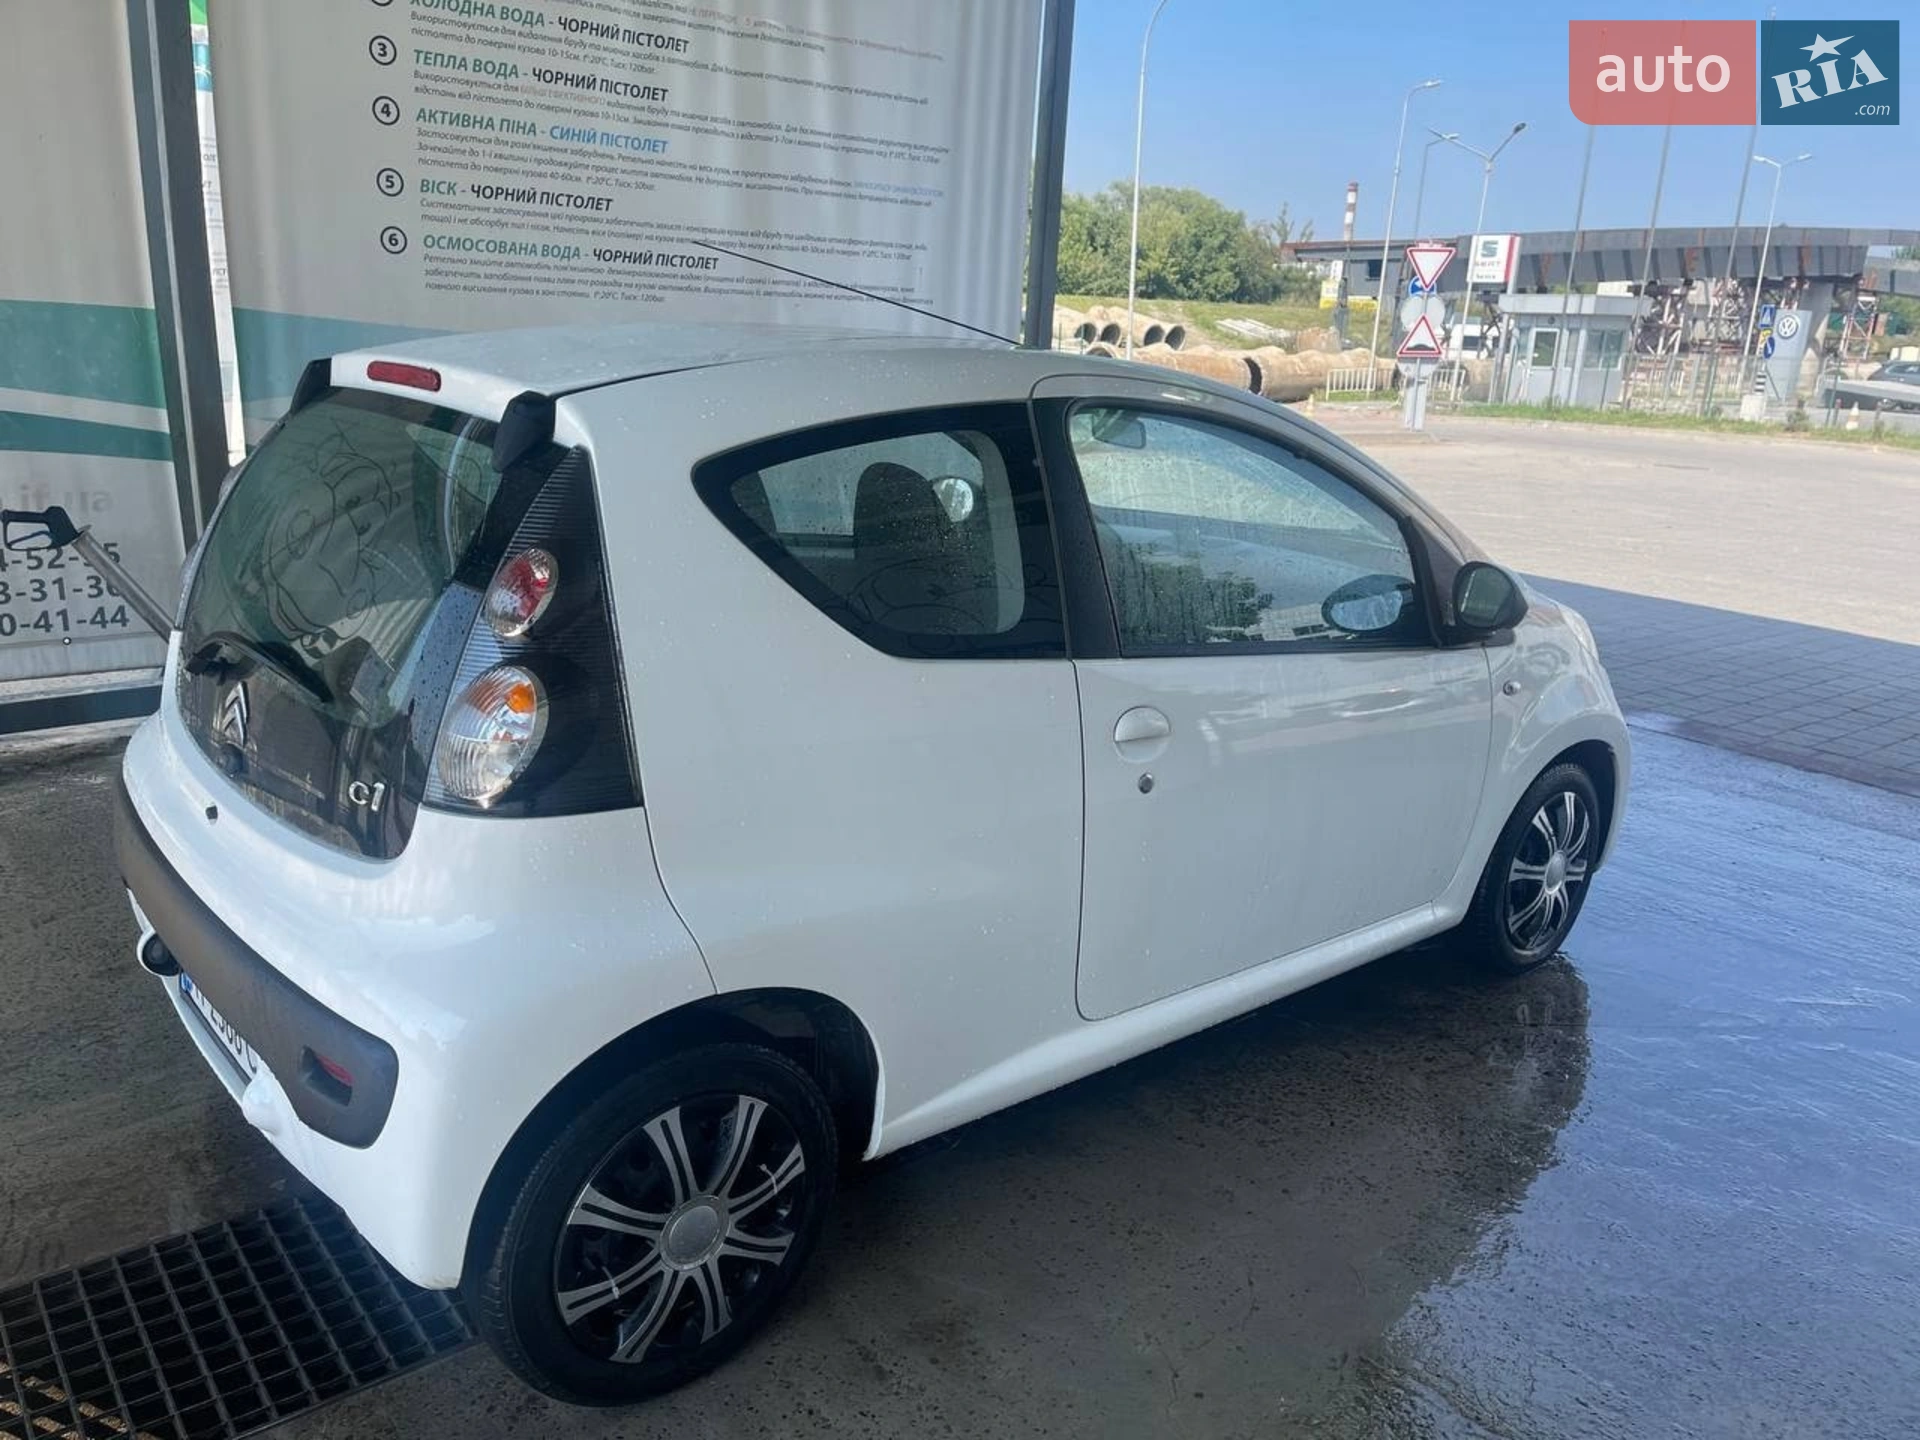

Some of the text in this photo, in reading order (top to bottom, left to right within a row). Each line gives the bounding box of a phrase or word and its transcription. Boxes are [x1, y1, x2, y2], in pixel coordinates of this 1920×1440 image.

[500, 9, 545, 28] ВОДА
[558, 16, 619, 41] ЧОРНИЙ
[622, 29, 690, 53] ПІСТОЛЕТ
[378, 43, 388, 57] 3
[414, 49, 468, 71] ТЕПЛА
[472, 58, 519, 80] ВОДА
[532, 67, 597, 91] ЧОРНИЙ
[600, 79, 669, 102] ПІСТОЛЕТ
[381, 103, 392, 117] 4
[416, 107, 497, 132] АКТИВНА
[499, 119, 537, 137] ПІНА
[550, 125, 596, 144] СИНІЙ
[600, 132, 669, 154] ПІСТОЛЕТ
[384, 175, 396, 188] 5
[420, 179, 458, 195] ВІСК
[470, 184, 536, 204] ЧОРНИЙ
[540, 191, 614, 211] ПІСТОЛЕТ
[388, 233, 398, 246] 6
[424, 234, 538, 257] ОСМОСОВАНА
[540, 244, 580, 262] ВОДА
[593, 248, 653, 266] ЧОРНИЙ
[655, 253, 719, 270] ПІСТОЛЕТ
[0, 542, 120, 572] -52-5
[0, 604, 129, 636] 0-41-44
[349, 780, 386, 812] C1
